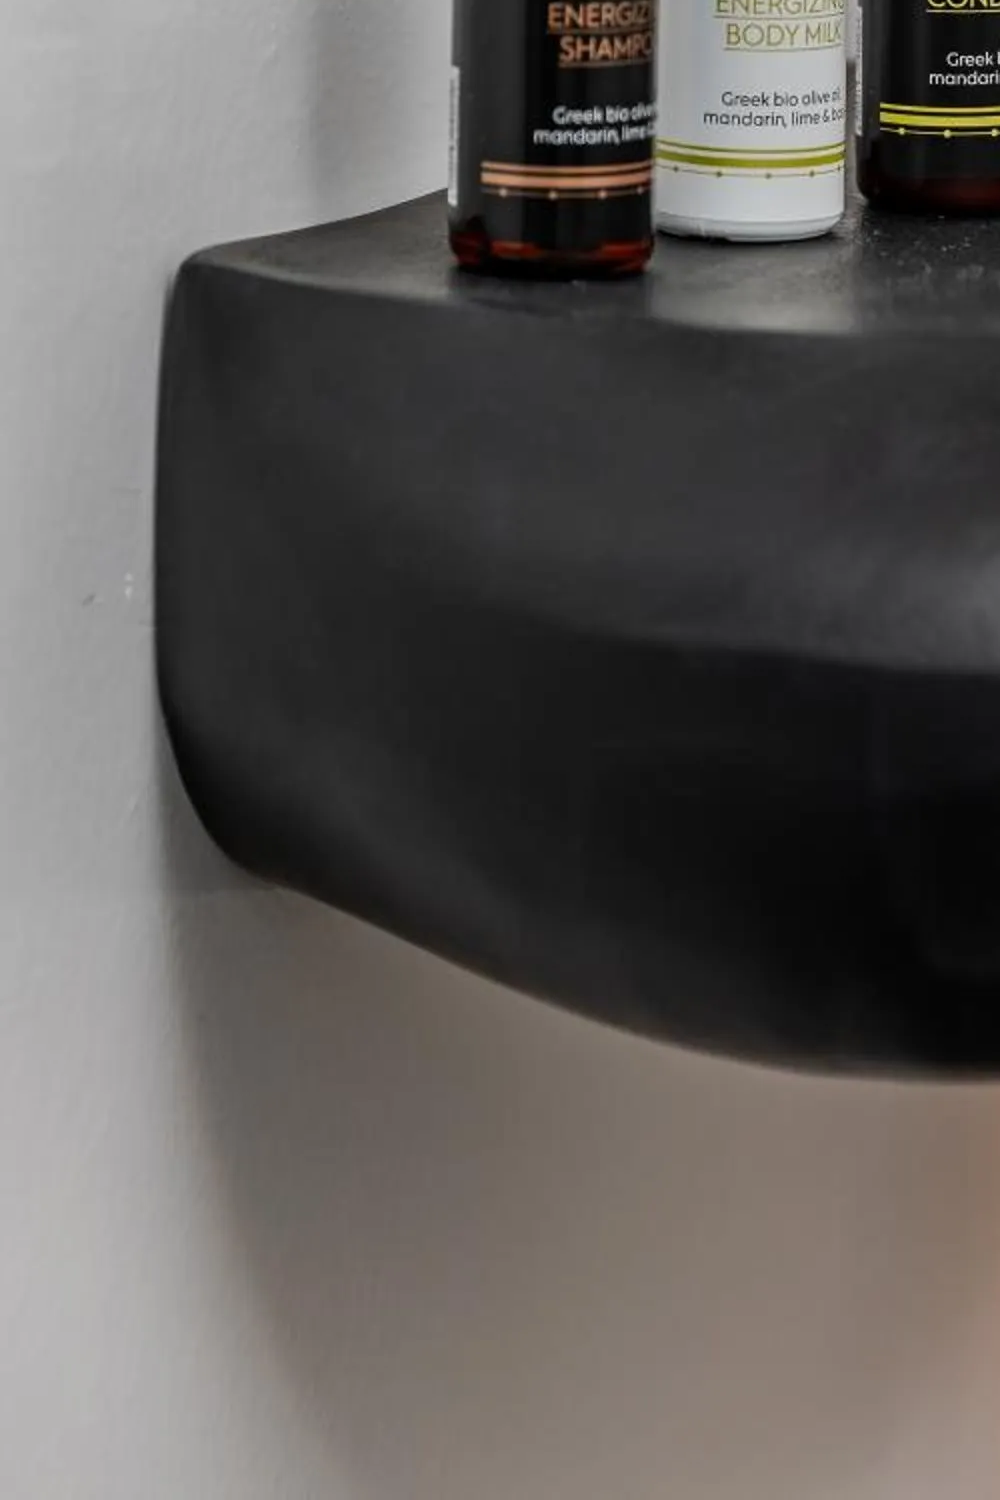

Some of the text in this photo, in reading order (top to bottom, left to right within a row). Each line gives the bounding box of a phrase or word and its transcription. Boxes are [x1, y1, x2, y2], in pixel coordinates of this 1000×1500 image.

[725, 19, 842, 47] BODY MILK
[946, 51, 994, 67] Greek
[721, 91, 769, 107] Greek
[773, 91, 799, 107] bio
[801, 89, 831, 105] olive
[552, 105, 601, 125] Greek
[605, 104, 630, 123] bio
[703, 111, 787, 129] mandarin,
[791, 112, 820, 127] lime
